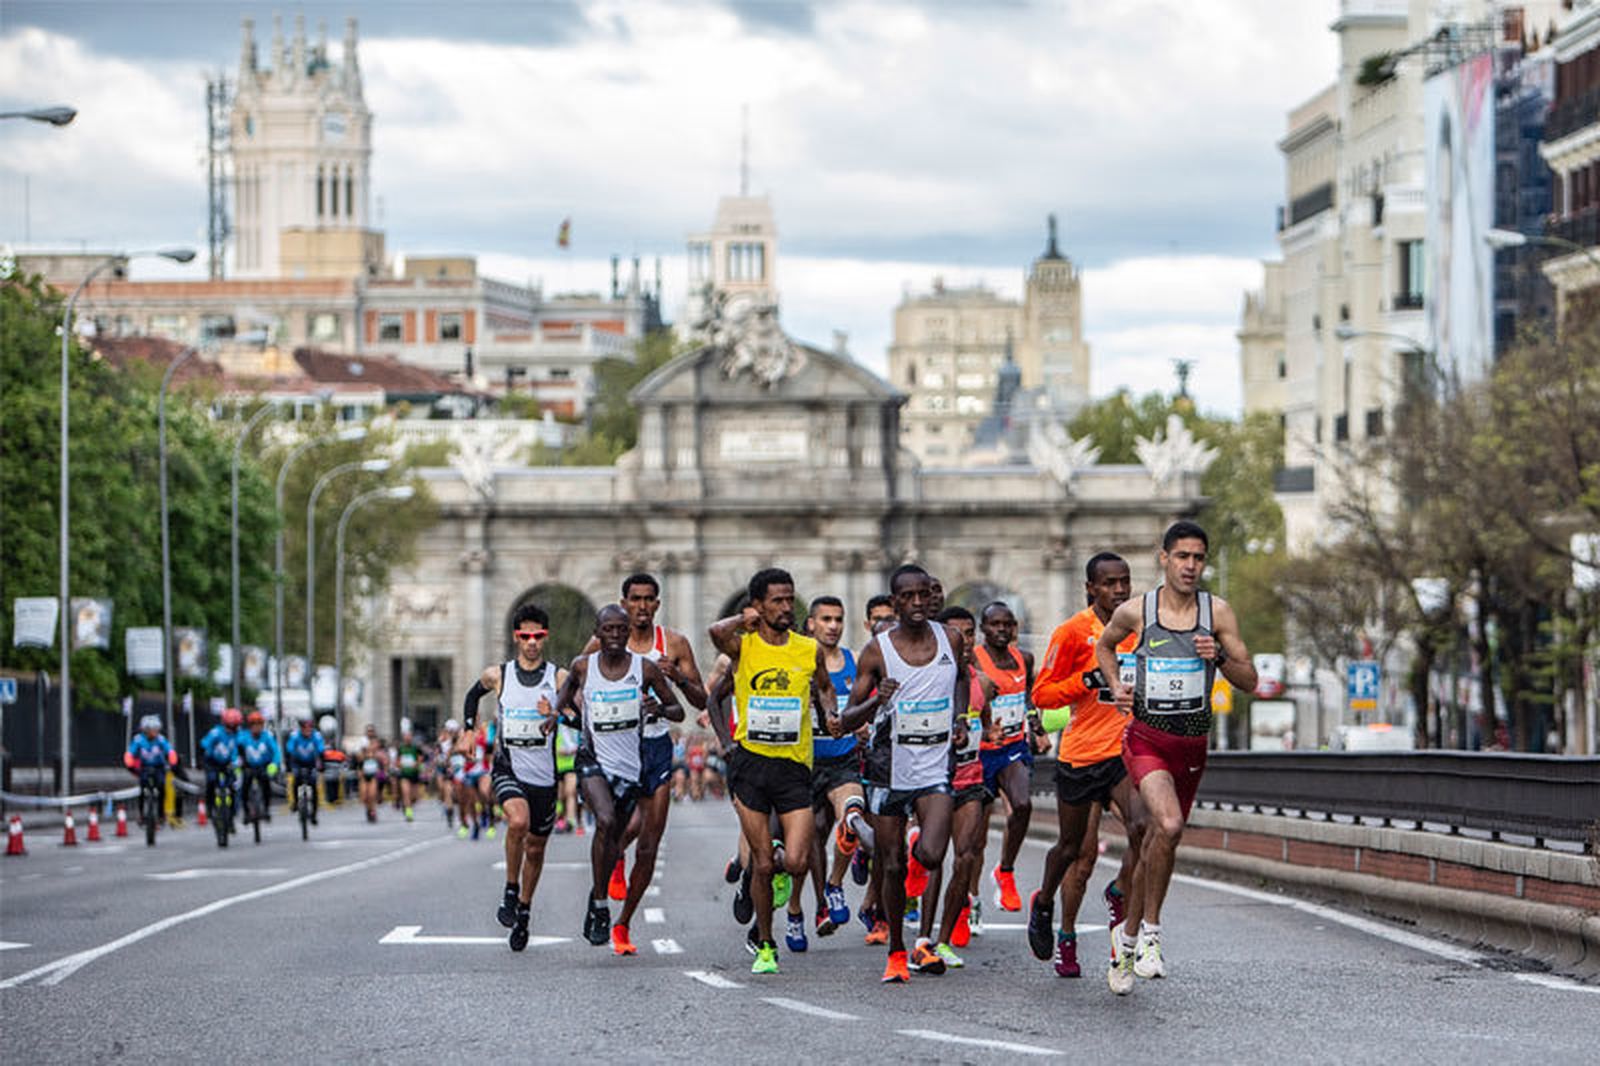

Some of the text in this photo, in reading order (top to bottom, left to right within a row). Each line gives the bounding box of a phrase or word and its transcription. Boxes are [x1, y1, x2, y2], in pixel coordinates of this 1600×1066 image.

[1169, 679, 1184, 691] 52
[767, 716, 780, 725] 38
[921, 719, 929, 727] 4
